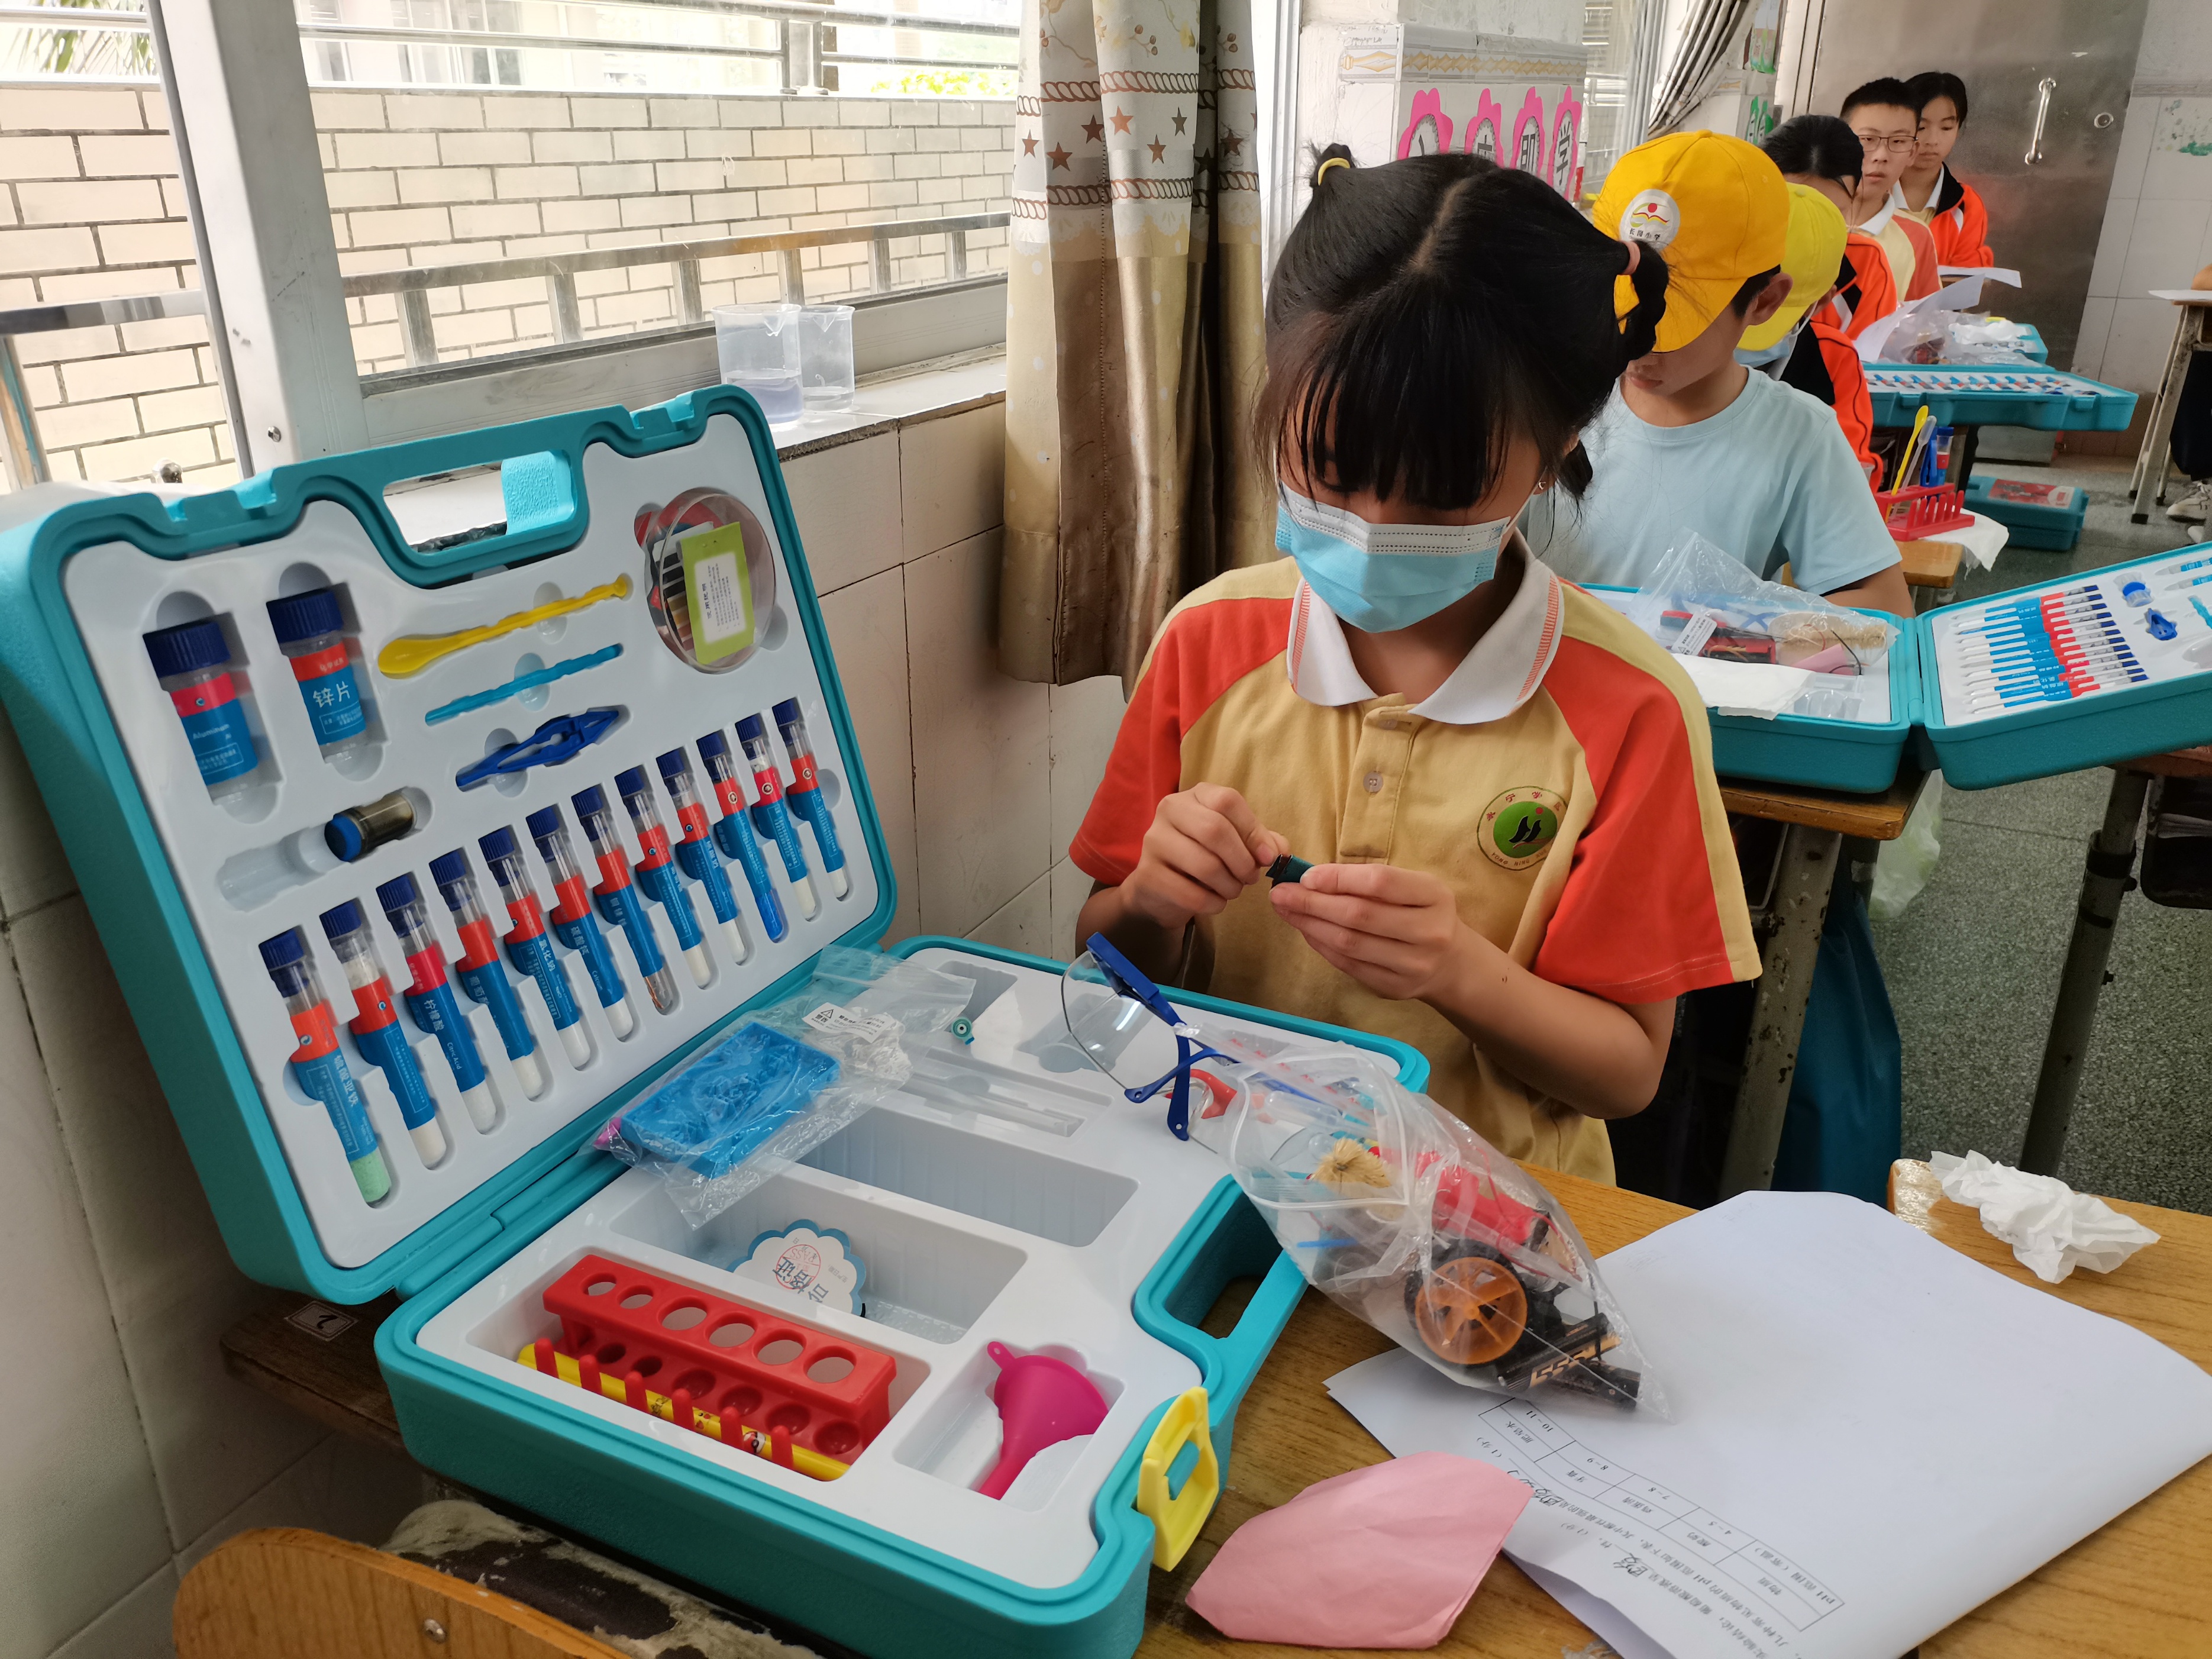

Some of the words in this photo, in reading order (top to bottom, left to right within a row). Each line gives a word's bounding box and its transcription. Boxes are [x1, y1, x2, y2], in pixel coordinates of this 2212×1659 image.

[313, 680, 351, 708] 锌片
[591, 970, 605, 992] Calcium
[424, 999, 445, 1032] 柠檬酸
[446, 1041, 458, 1058] Citric
[453, 1056, 463, 1070] Acid
[334, 1056, 360, 1107] 硫酸亚铁
[790, 1248, 817, 1263] PASS
[1505, 1421, 1535, 1444] 肥皂水
[1565, 1470, 1587, 1483] 牙膏
[1686, 1531, 1711, 1548] 酸奶
[1756, 1577, 1782, 1596] 物质
